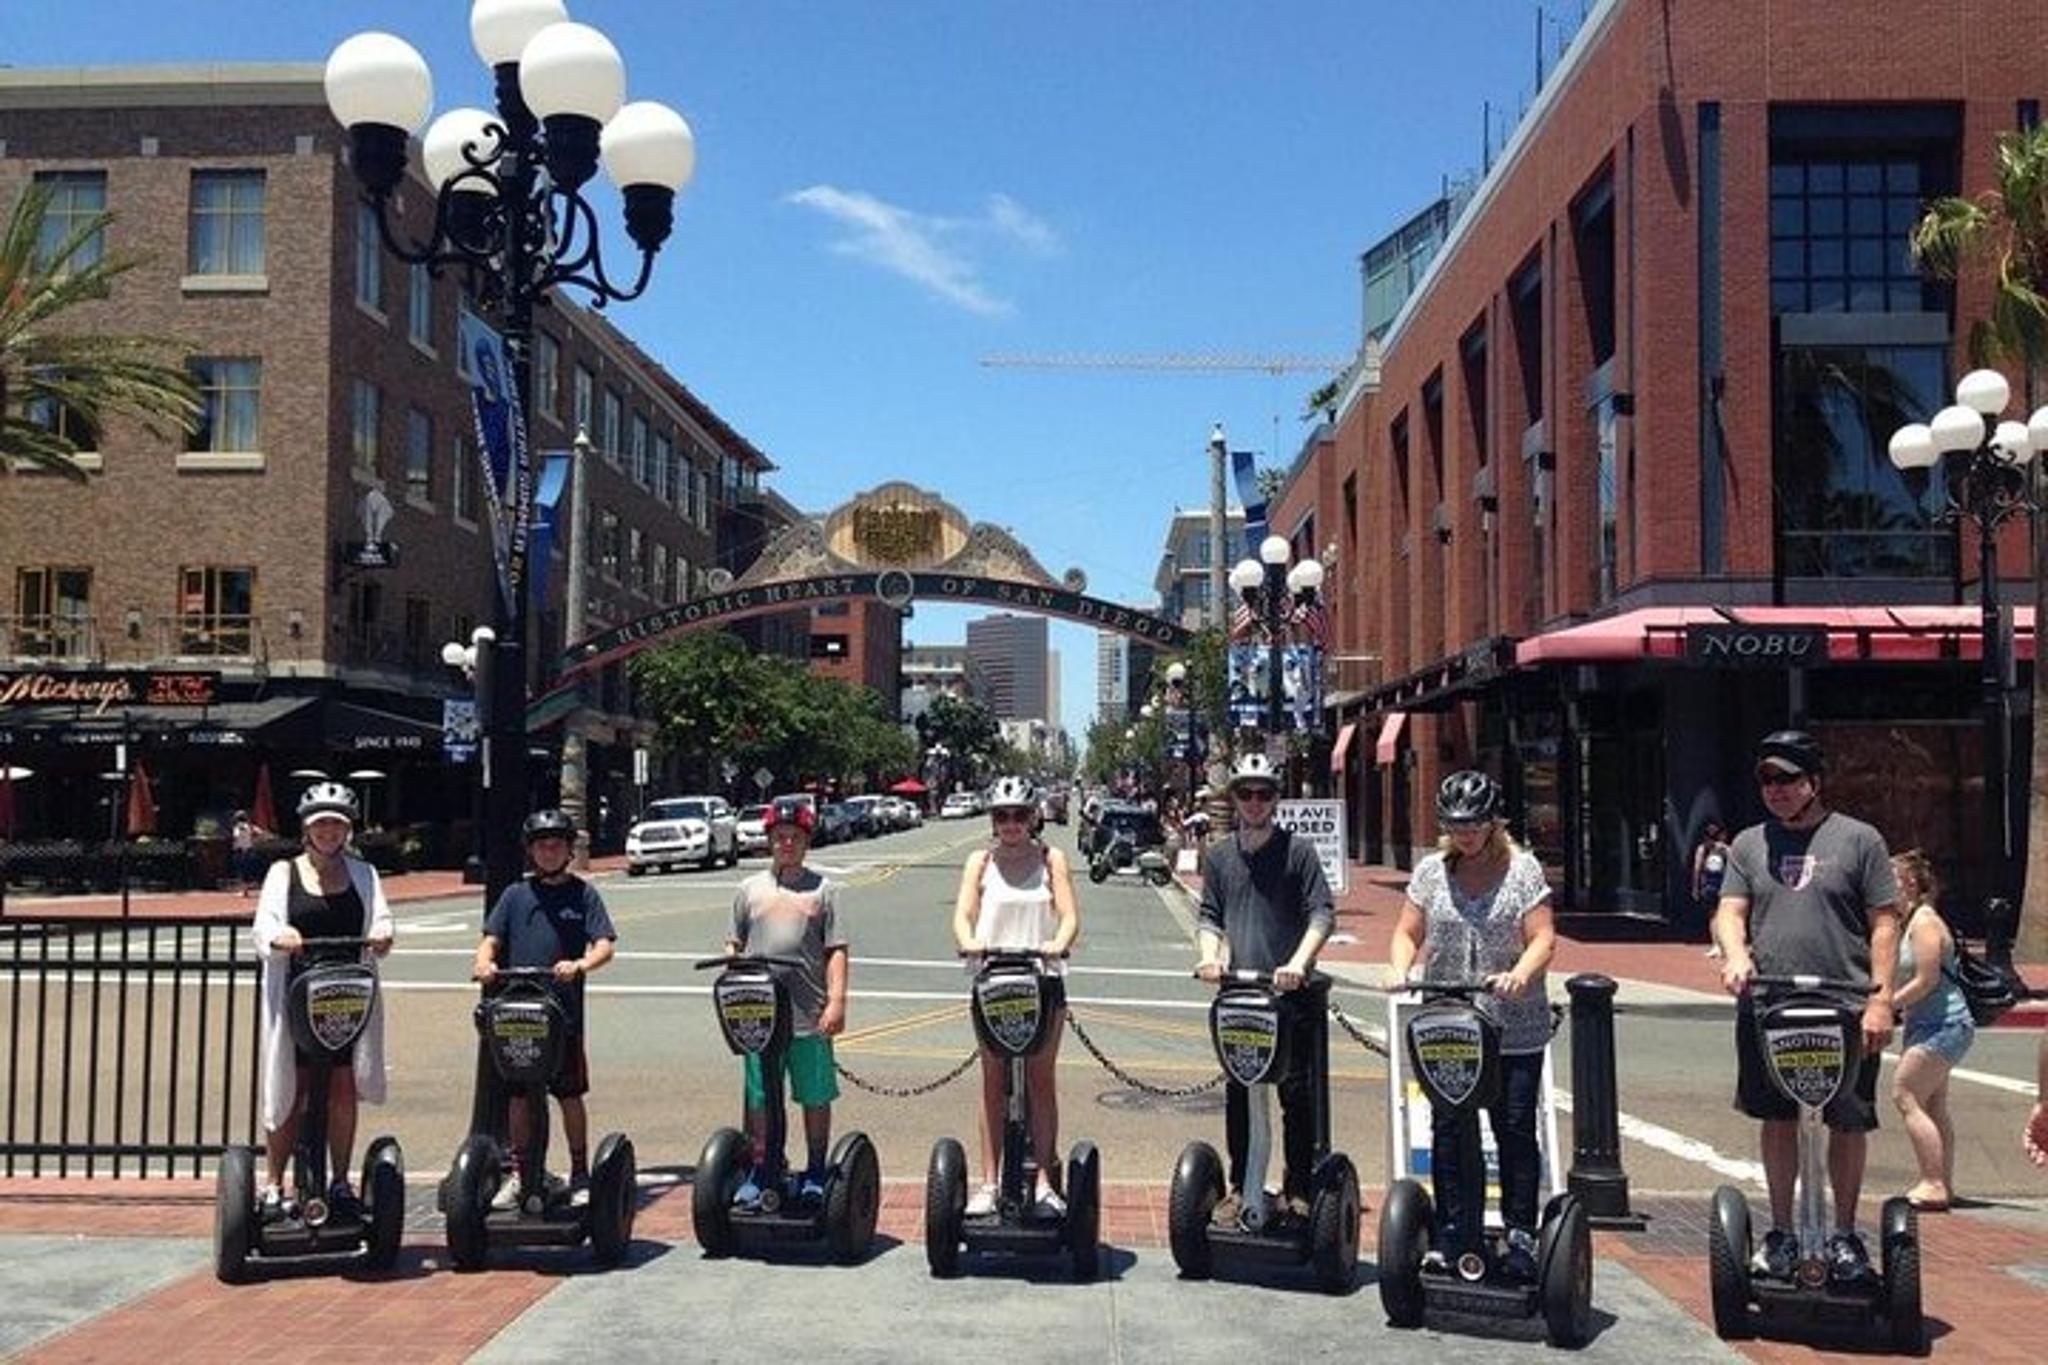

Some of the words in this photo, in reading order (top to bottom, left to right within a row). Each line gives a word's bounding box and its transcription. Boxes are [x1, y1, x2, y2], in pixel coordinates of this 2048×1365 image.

[616, 591, 752, 645] HISTORIC
[765, 578, 855, 603] HEART
[943, 579, 977, 597] OF
[997, 583, 1056, 608] SAN
[1077, 599, 1174, 641] DIEGO
[1702, 632, 1813, 656] NOBU
[1284, 821, 1335, 834] OSED
